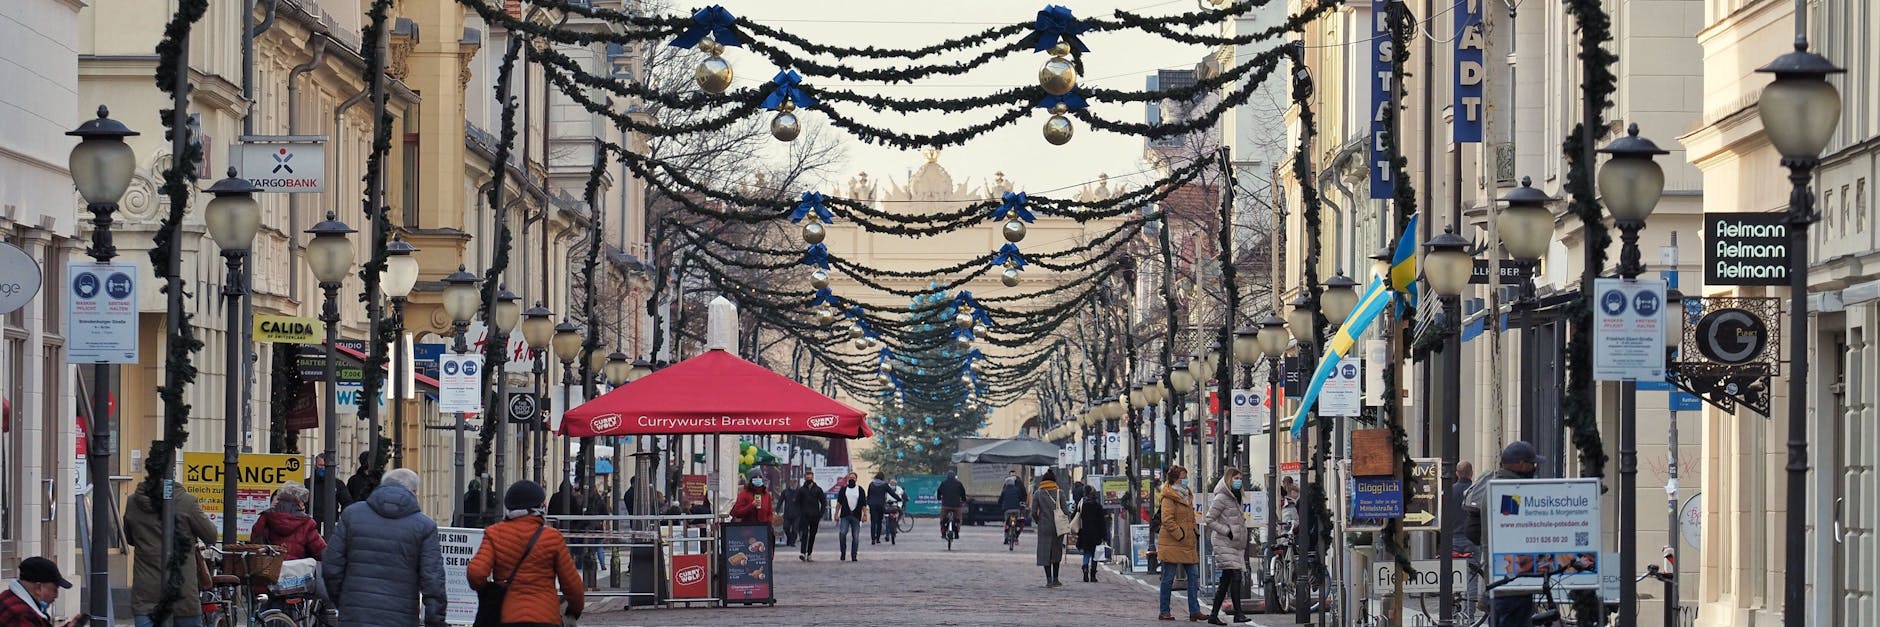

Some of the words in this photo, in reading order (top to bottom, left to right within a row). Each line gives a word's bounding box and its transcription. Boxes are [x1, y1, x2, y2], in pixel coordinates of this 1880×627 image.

[249, 179, 317, 187] TARGOBANK
[0, 283, 20, 297] ge
[261, 321, 313, 336] CALIDA
[594, 416, 617, 425] CURRY
[638, 416, 716, 428] Currywurst
[721, 416, 791, 426] Bratwurst
[286, 461, 298, 469] AG
[1524, 496, 1588, 508] Musikschule
[449, 534, 467, 543] SIND
[440, 545, 473, 555] EITERHIN
[446, 557, 458, 566] SIE
[679, 568, 700, 578] CURRY
